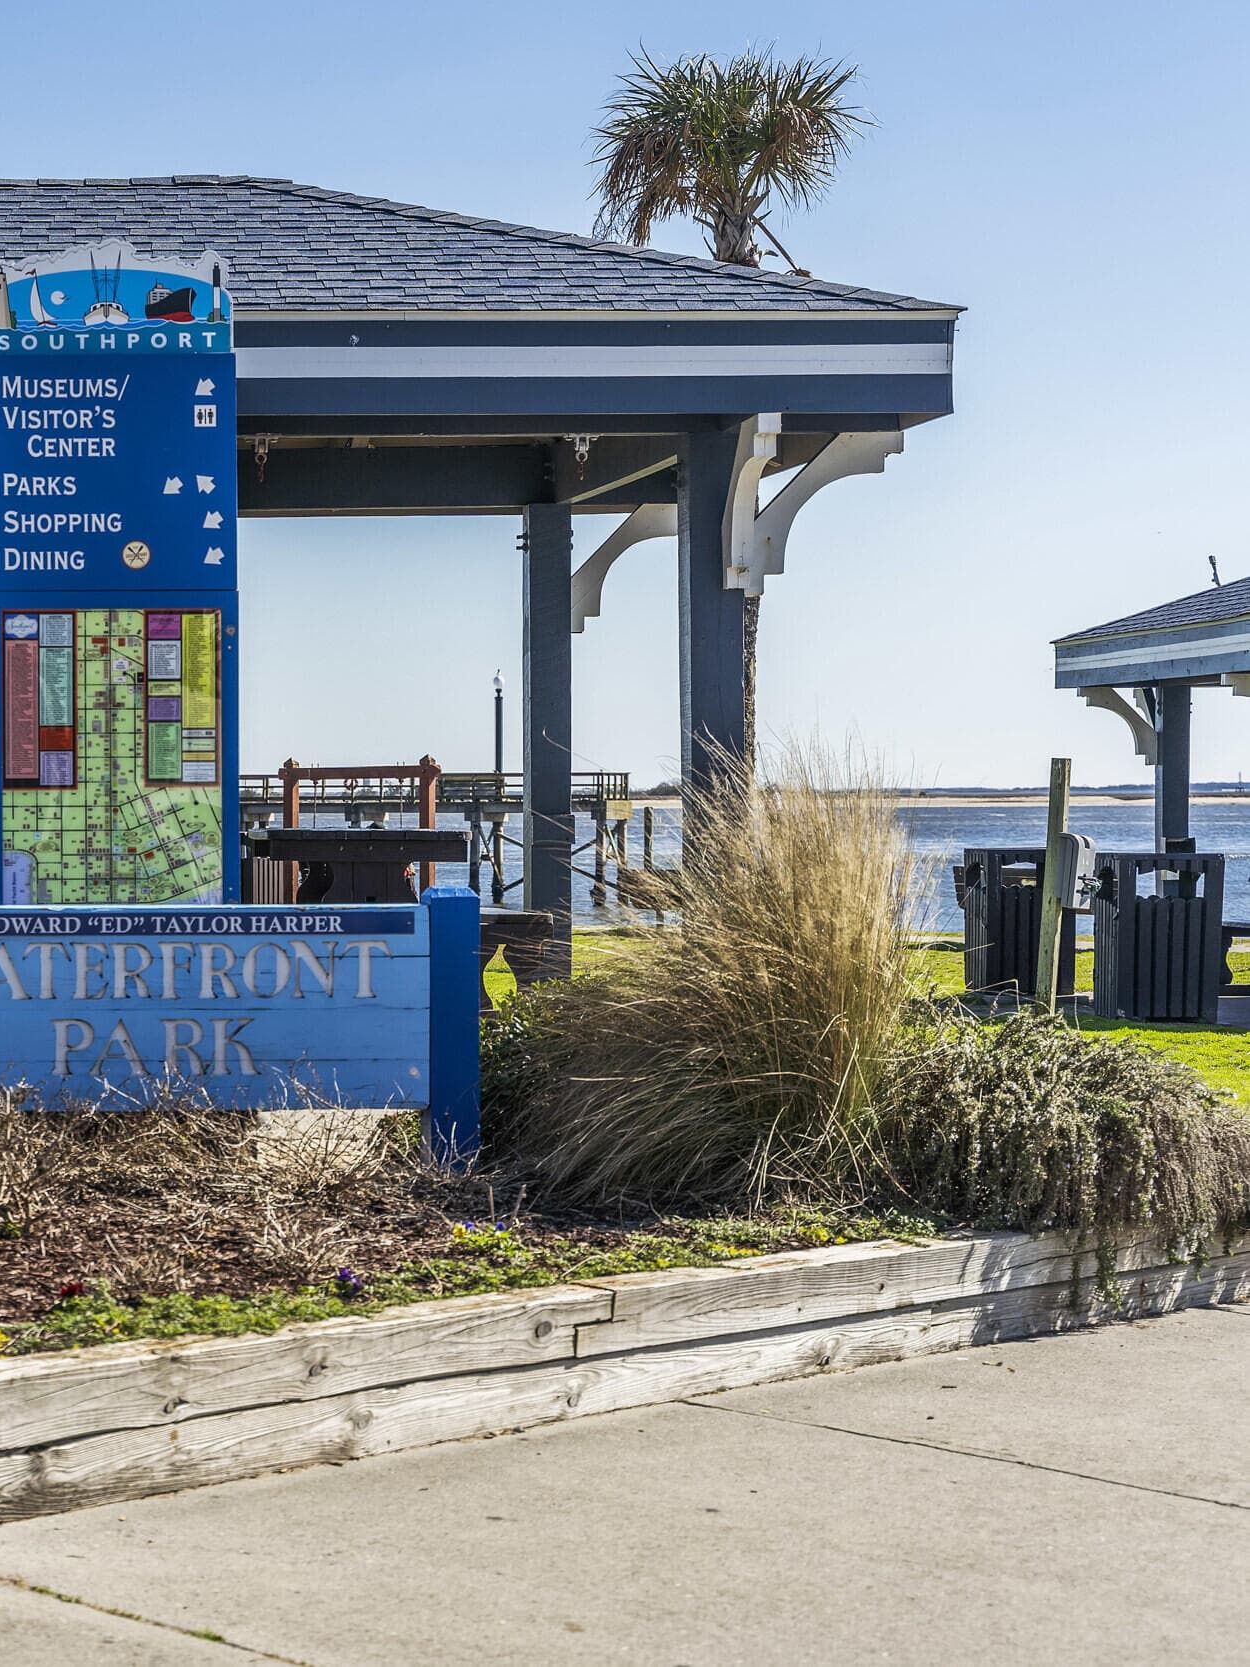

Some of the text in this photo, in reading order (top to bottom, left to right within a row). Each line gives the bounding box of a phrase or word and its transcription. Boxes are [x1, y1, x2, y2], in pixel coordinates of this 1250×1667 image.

[2, 374, 130, 401] MUSEUMS/
[3, 405, 116, 430] VISITOR’S
[27, 434, 116, 458] CENTER
[3, 473, 77, 496] PARKS
[3, 510, 122, 534] SHOPPING
[4, 547, 85, 571] DINING
[152, 916, 245, 933] TAYLOR
[250, 916, 343, 933] HARPER
[52, 1017, 262, 1077] PARK
